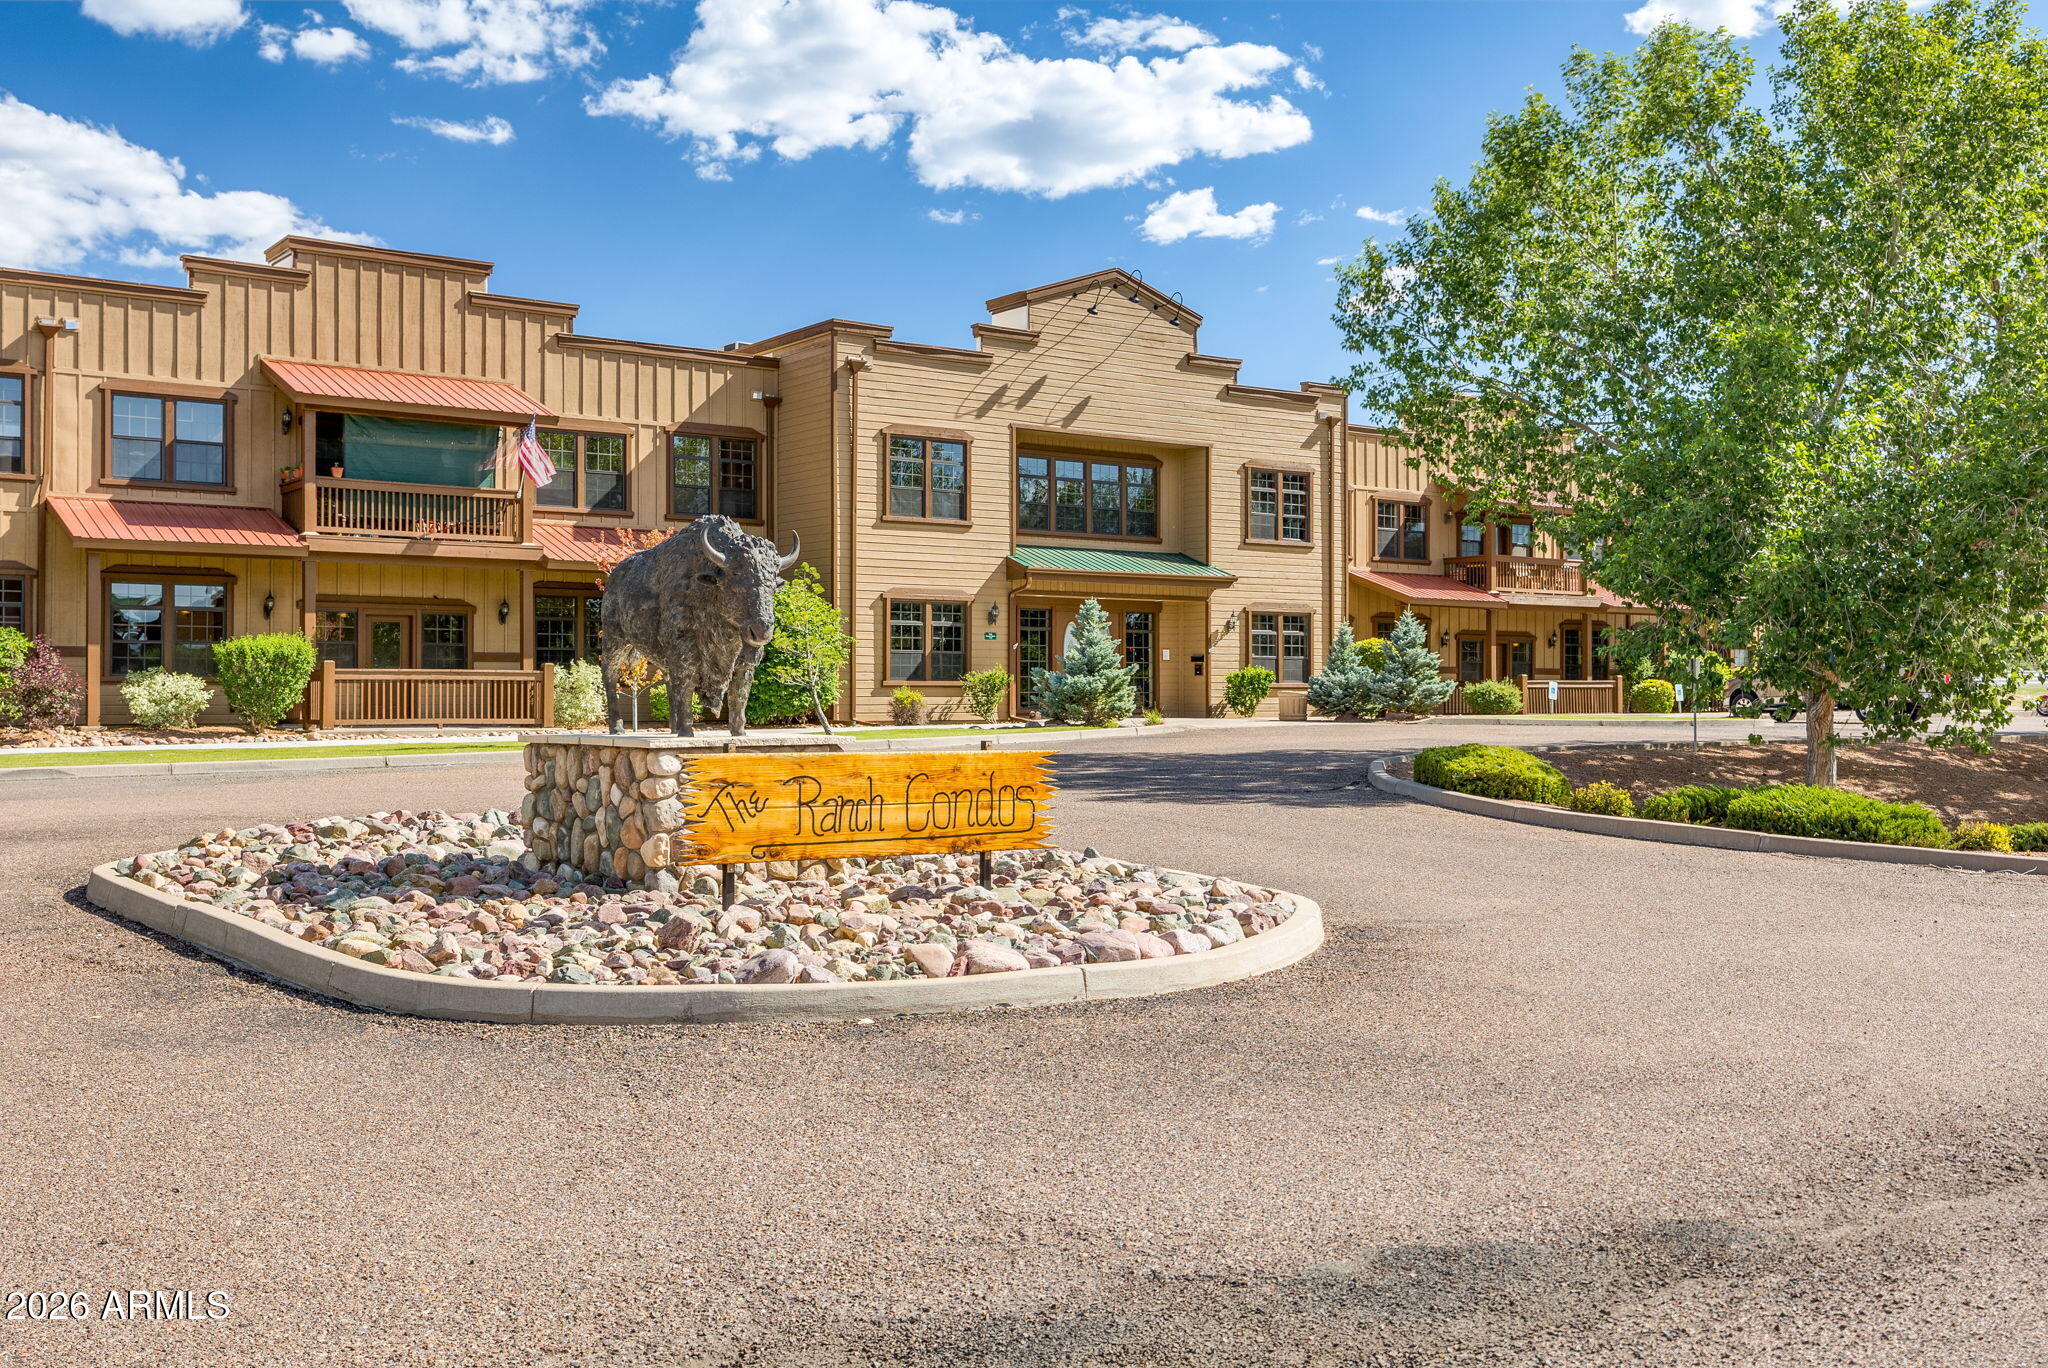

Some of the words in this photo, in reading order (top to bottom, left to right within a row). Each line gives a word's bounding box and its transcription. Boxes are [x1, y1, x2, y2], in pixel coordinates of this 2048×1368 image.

[698, 781, 769, 832] The
[783, 775, 889, 837] Ranch
[905, 771, 1036, 833] Condos
